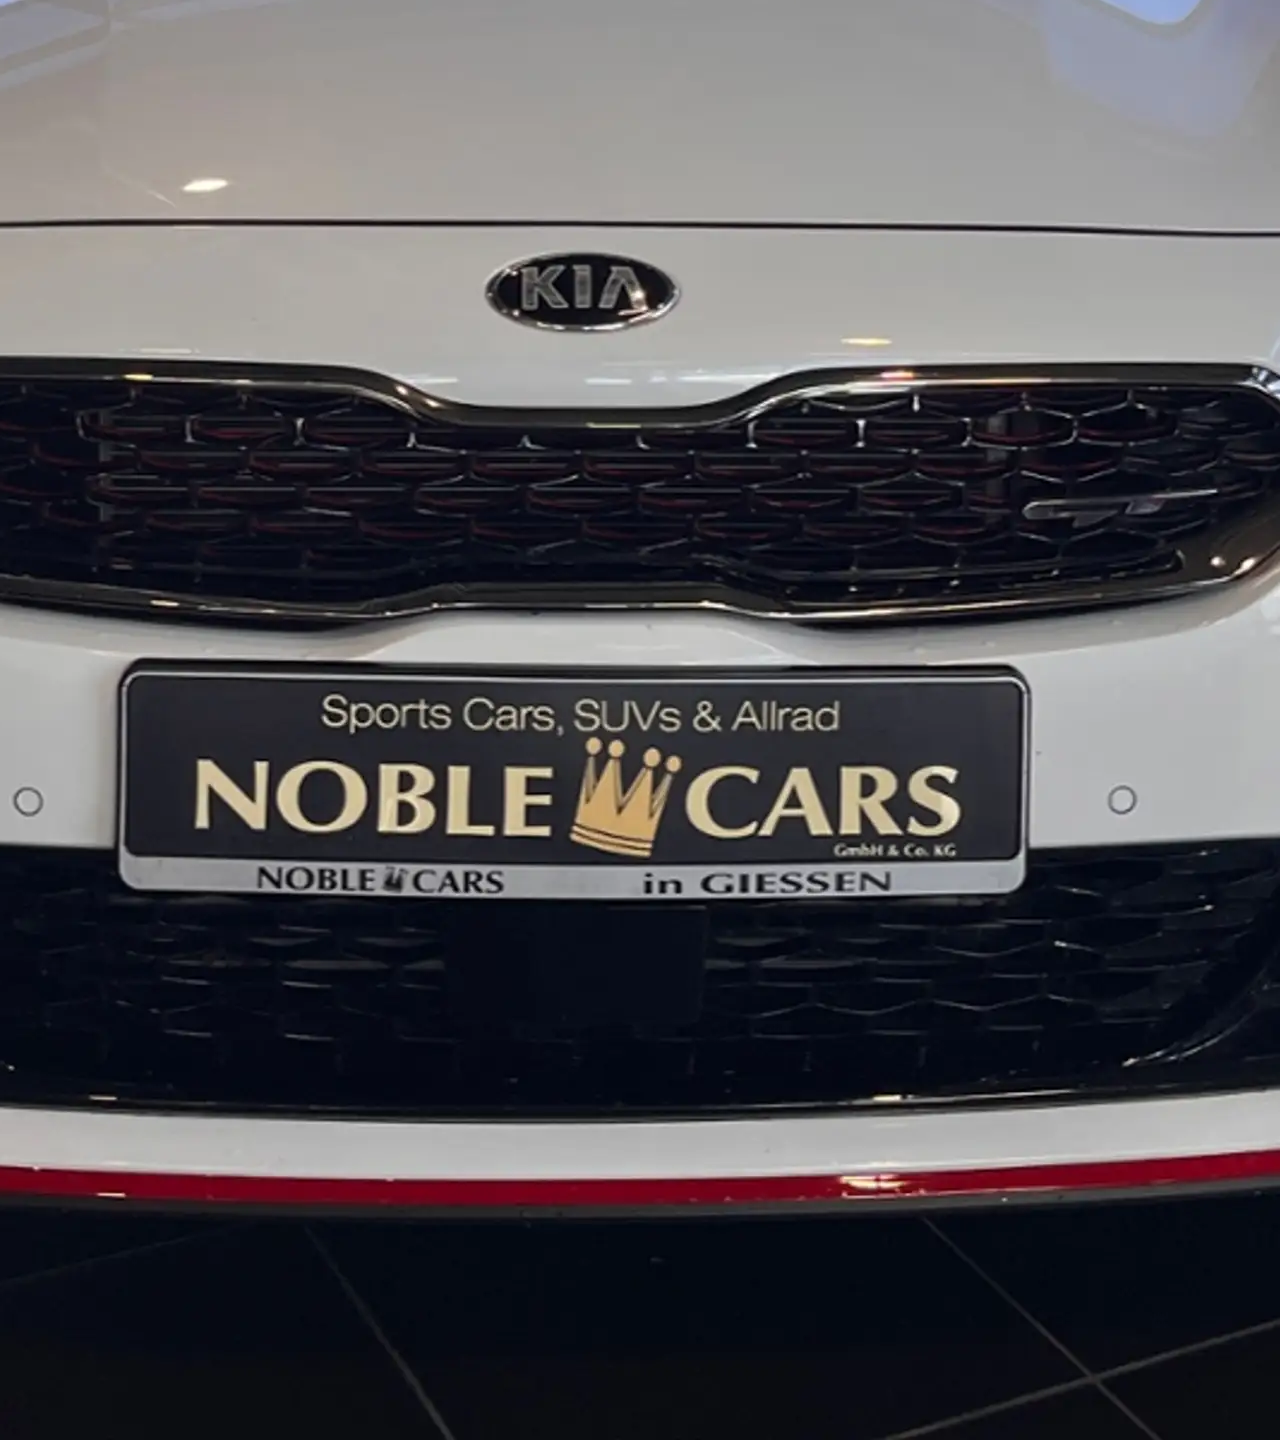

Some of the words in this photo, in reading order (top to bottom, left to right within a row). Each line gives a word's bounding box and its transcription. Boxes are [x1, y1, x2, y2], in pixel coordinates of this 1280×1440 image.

[521, 263, 649, 312] KIA
[321, 693, 452, 735] Sports
[463, 696, 564, 737] Cars,
[573, 698, 682, 733] SUVs
[692, 700, 723, 733] &
[731, 700, 841, 732] Allrad
[194, 758, 554, 838] NOBLE
[684, 764, 962, 840] CARS
[833, 842, 883, 858] GmbH
[887, 843, 900, 858] &
[933, 843, 957, 858] KG
[256, 865, 376, 892] NOBLE
[411, 869, 505, 895] CARS
[642, 872, 683, 895] in
[699, 871, 892, 895] GIESSEN
